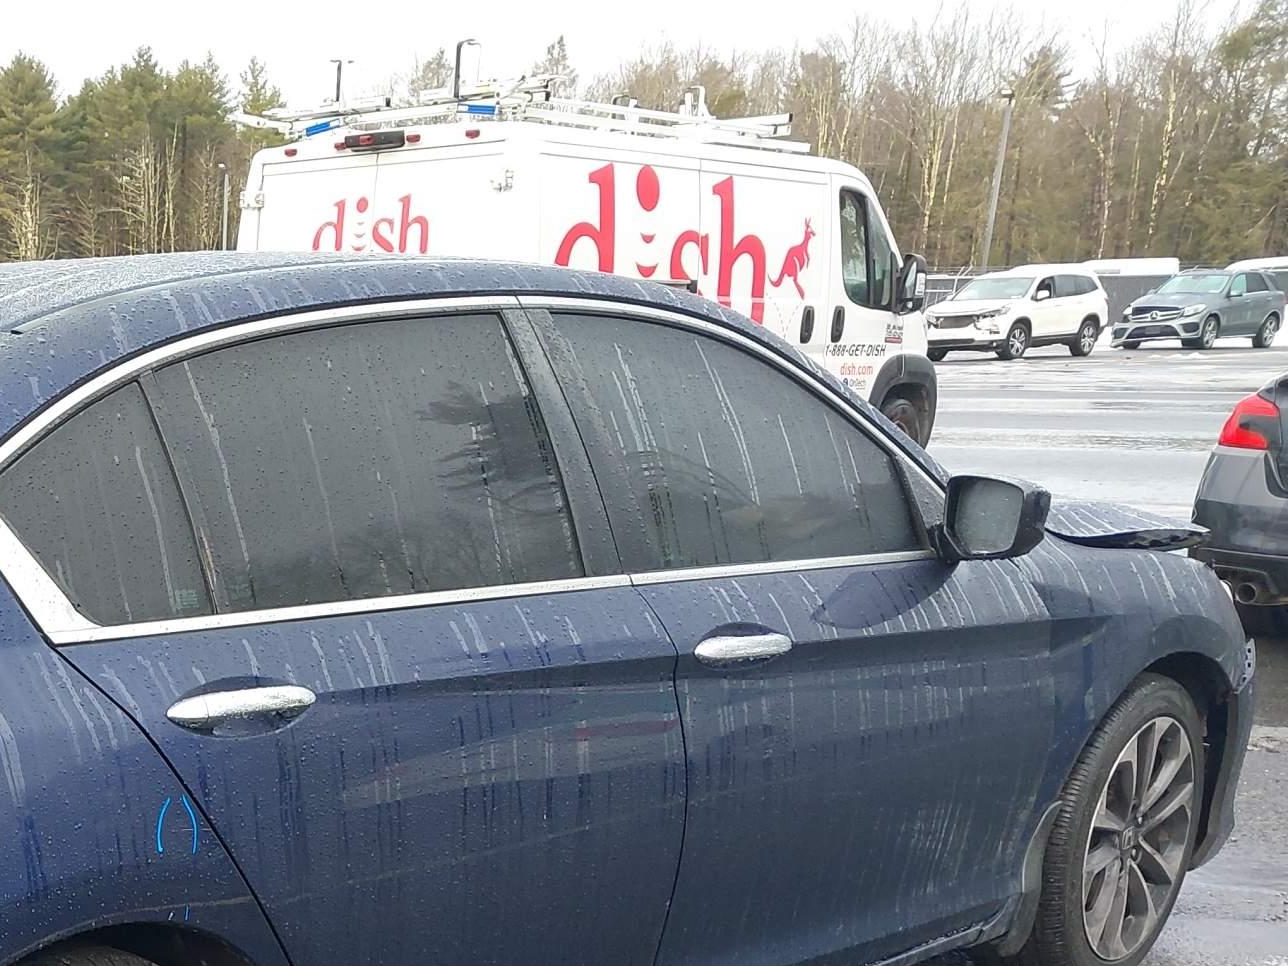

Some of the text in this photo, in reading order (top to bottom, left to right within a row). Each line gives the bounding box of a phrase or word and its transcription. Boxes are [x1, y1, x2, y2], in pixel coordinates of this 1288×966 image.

[312, 193, 428, 254] dish
[825, 344, 886, 356] 1-888-GET-DISH
[840, 362, 873, 375] dish.com
